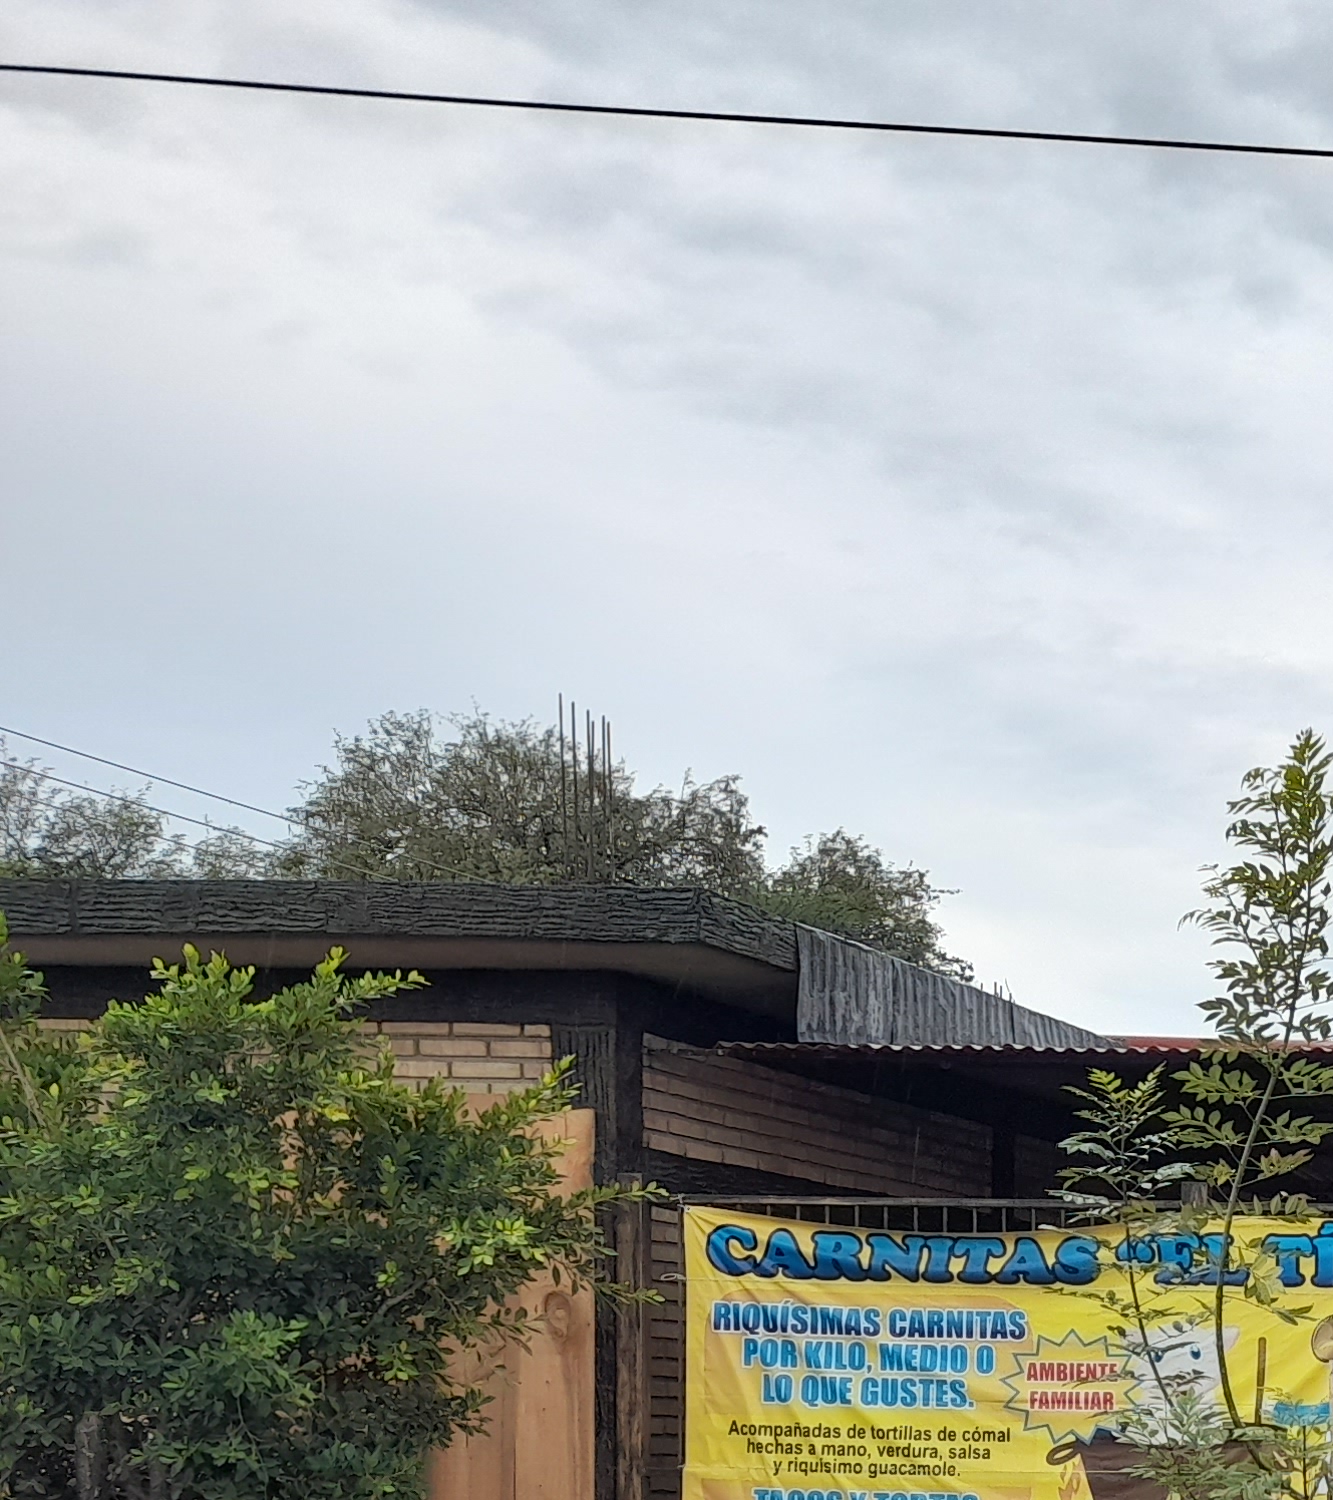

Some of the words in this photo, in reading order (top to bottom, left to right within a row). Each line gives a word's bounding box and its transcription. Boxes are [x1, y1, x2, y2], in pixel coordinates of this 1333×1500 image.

[706, 1223, 1101, 1286] CARNITAS
[713, 1299, 881, 1337] RIQUÍSIMAS
[888, 1309, 1027, 1340] CARNITAS
[743, 1338, 798, 1369] POR
[804, 1341, 873, 1374] KILO,
[879, 1343, 968, 1374] MEDIO
[976, 1344, 996, 1374] O
[1026, 1362, 1118, 1382] AMBIENTE
[762, 1374, 794, 1403] LO
[801, 1375, 852, 1407] QUE
[861, 1377, 974, 1407] GUSTES.
[1029, 1390, 1115, 1411] FAMILIAR
[728, 1420, 842, 1441] Acompañadas
[846, 1424, 867, 1439] de
[871, 1425, 932, 1441] tortillas
[937, 1426, 957, 1442] de
[962, 1426, 1011, 1443] cómal
[746, 1437, 803, 1455] hechas
[807, 1443, 816, 1455] a
[821, 1443, 872, 1460] mano,
[877, 1441, 943, 1460] verdura,
[948, 1444, 991, 1459] salsa
[773, 1460, 783, 1476] y
[787, 1457, 863, 1476] riquísimo
[868, 1460, 961, 1478] guacamole.
